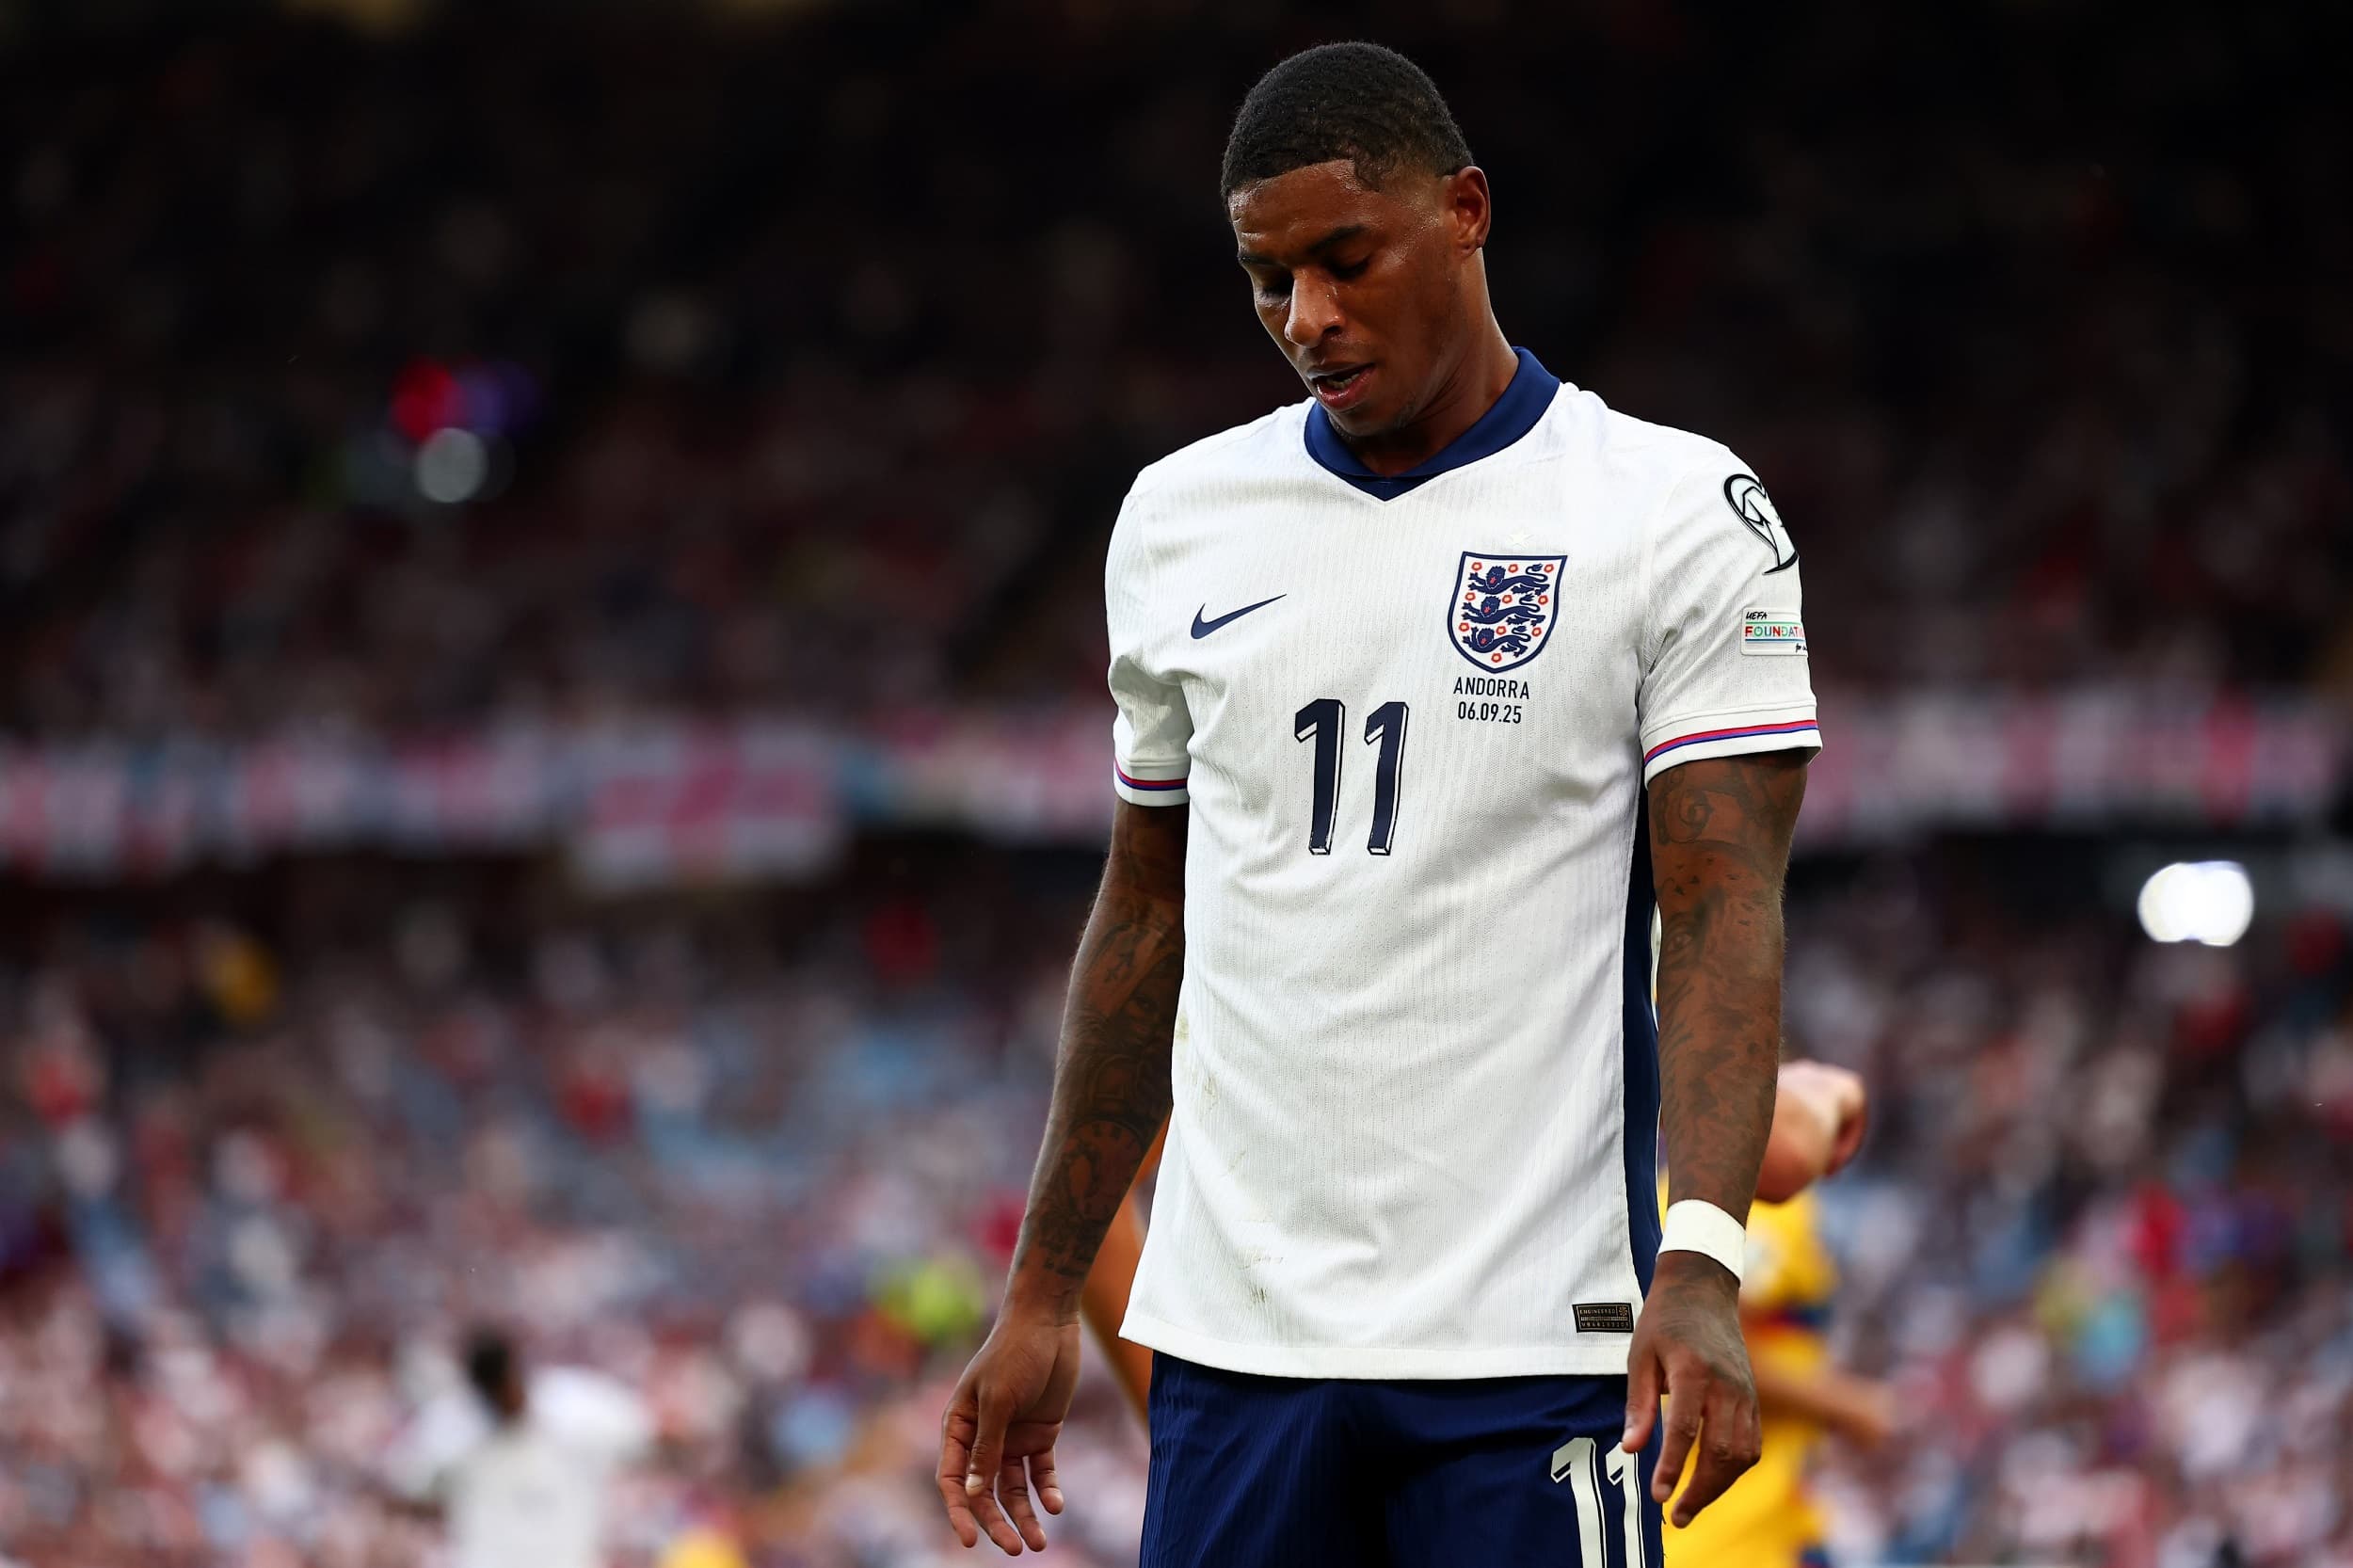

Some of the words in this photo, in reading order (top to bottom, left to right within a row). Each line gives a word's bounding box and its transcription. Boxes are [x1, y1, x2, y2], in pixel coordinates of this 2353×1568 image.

[1746, 611, 1768, 620] UEFA
[1453, 677, 1529, 699] ANDORRA
[1458, 701, 1522, 724] 06.09.25
[1294, 698, 1409, 856] 11
[1550, 1437, 1646, 1568] 11
